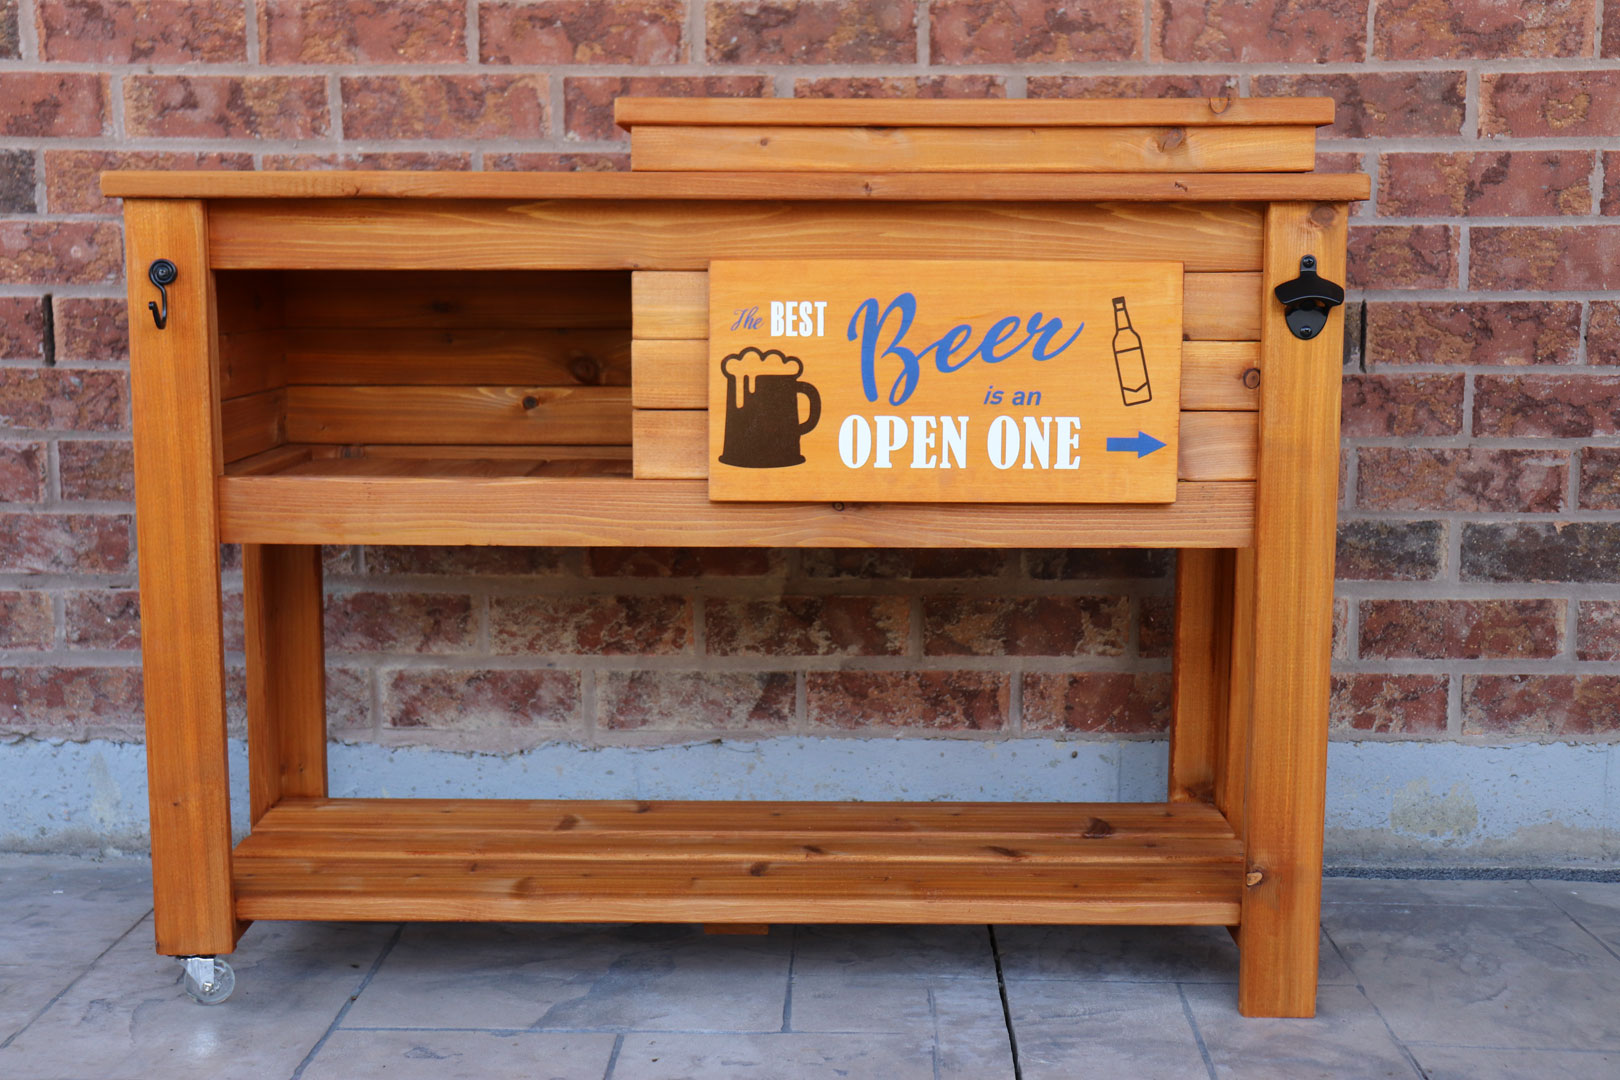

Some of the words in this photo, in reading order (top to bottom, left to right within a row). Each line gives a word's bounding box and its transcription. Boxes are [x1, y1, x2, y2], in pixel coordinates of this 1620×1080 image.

[730, 306, 764, 332] The
[770, 301, 828, 337] BEST
[847, 292, 1085, 406] Beer
[983, 385, 1004, 405] is
[1011, 389, 1042, 406] an
[838, 414, 970, 469] OPEN
[987, 415, 1081, 470] ONE
